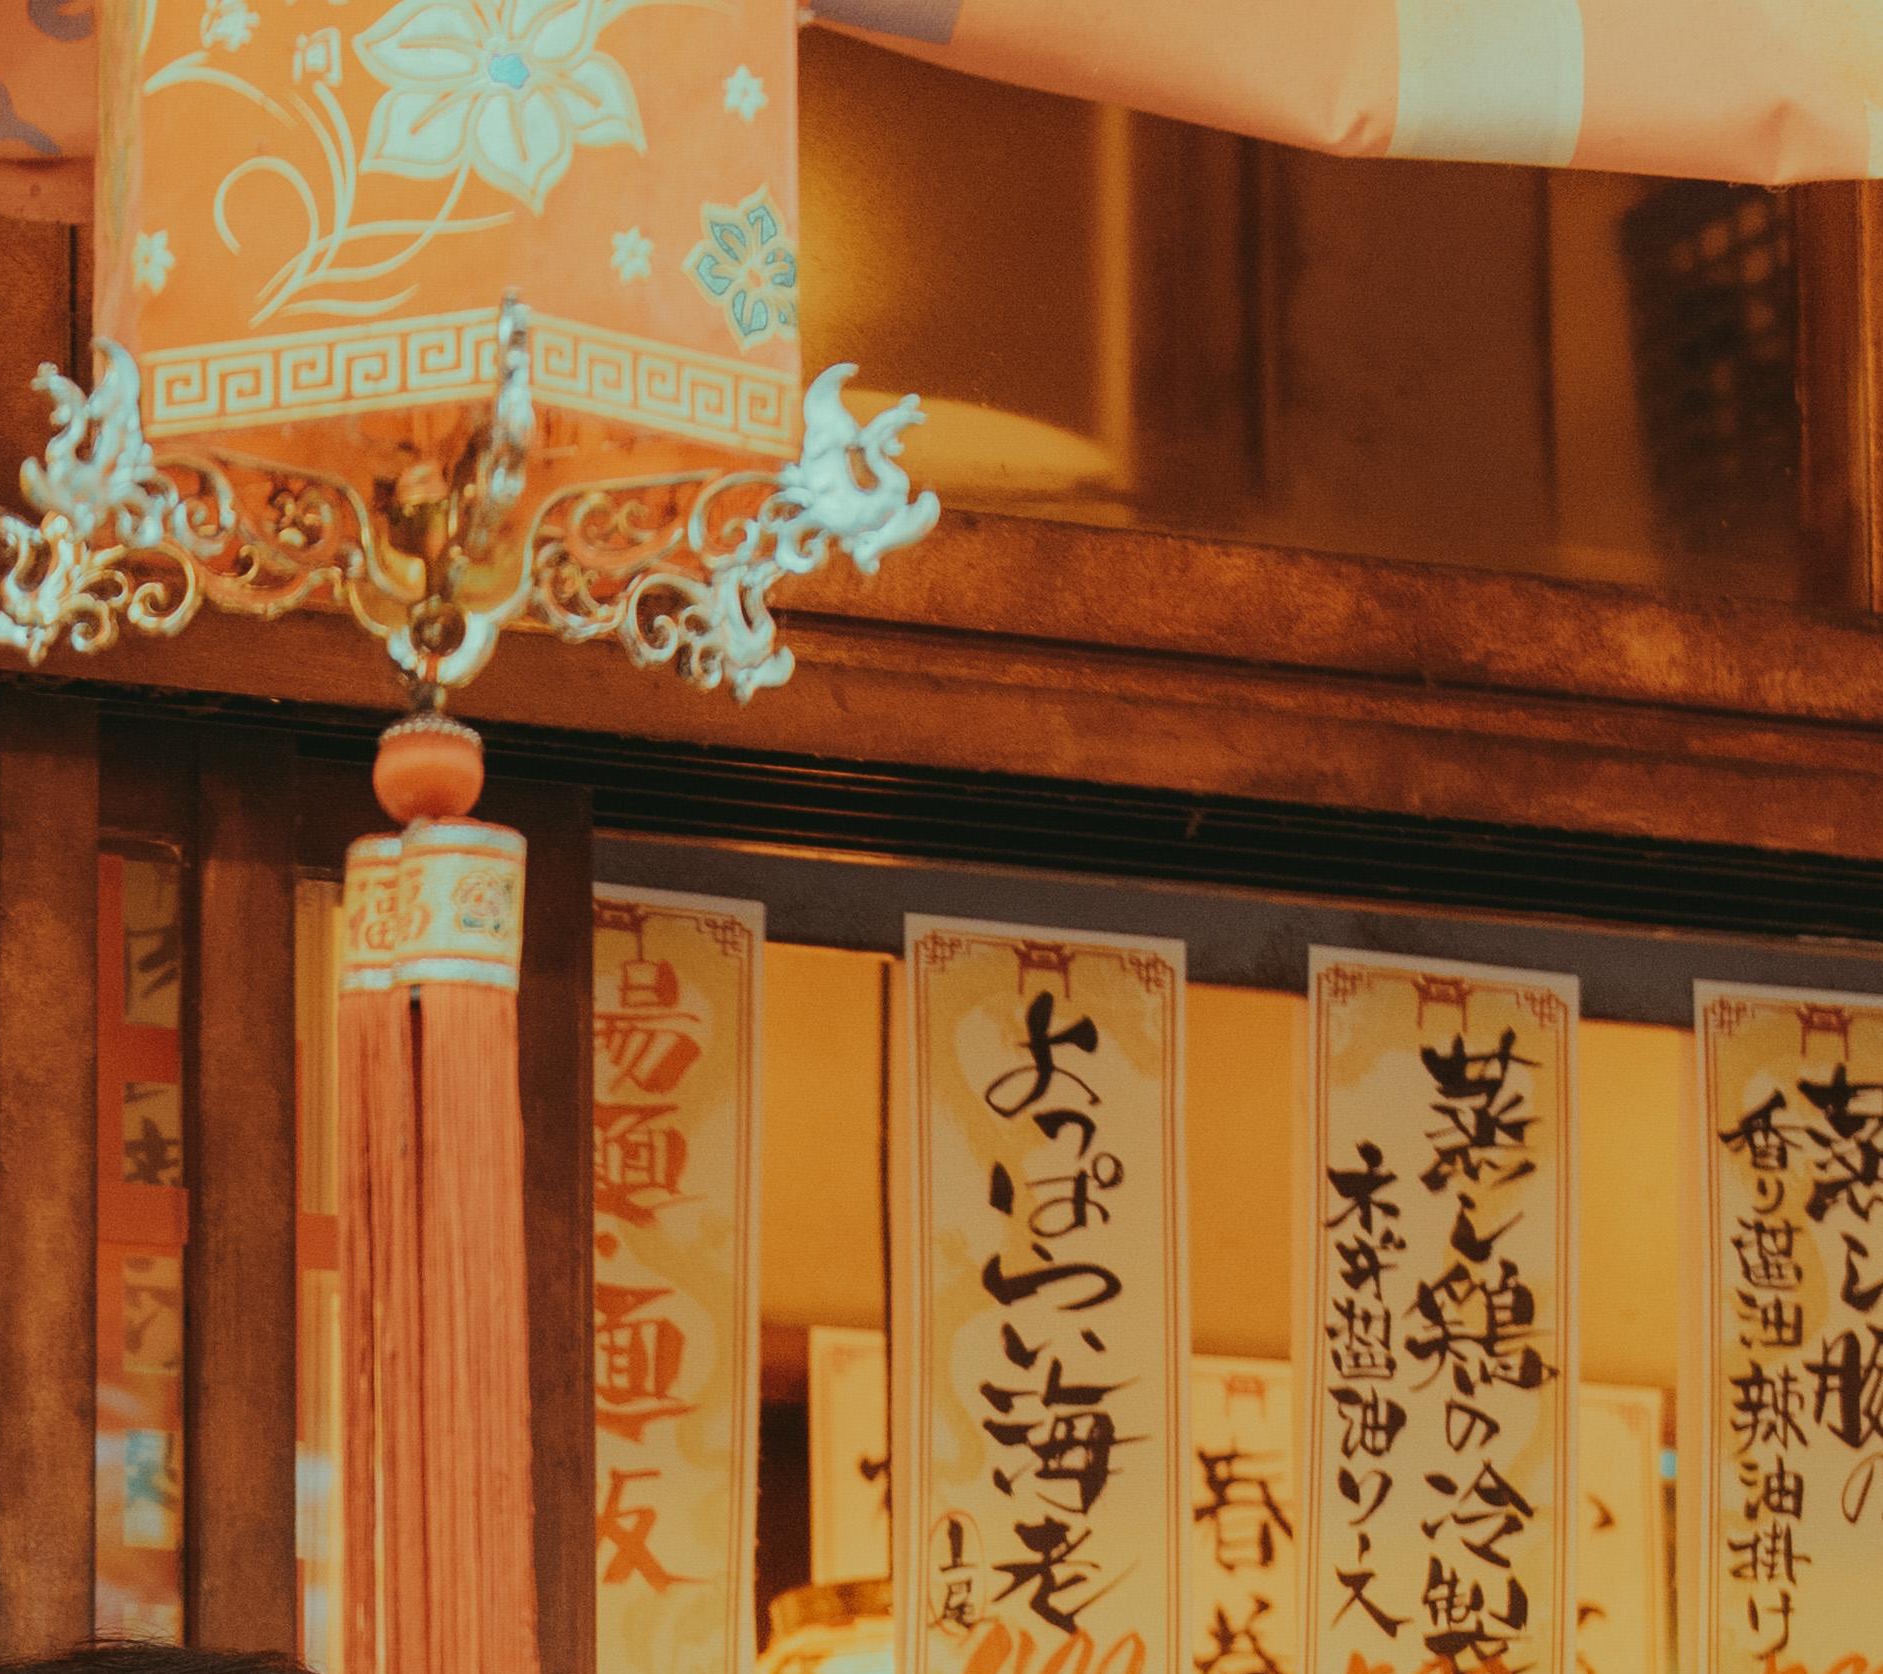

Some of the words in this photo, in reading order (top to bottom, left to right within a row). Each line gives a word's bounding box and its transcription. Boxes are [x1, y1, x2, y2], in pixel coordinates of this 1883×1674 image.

[982, 991, 1144, 1636] よっぱらい海老
